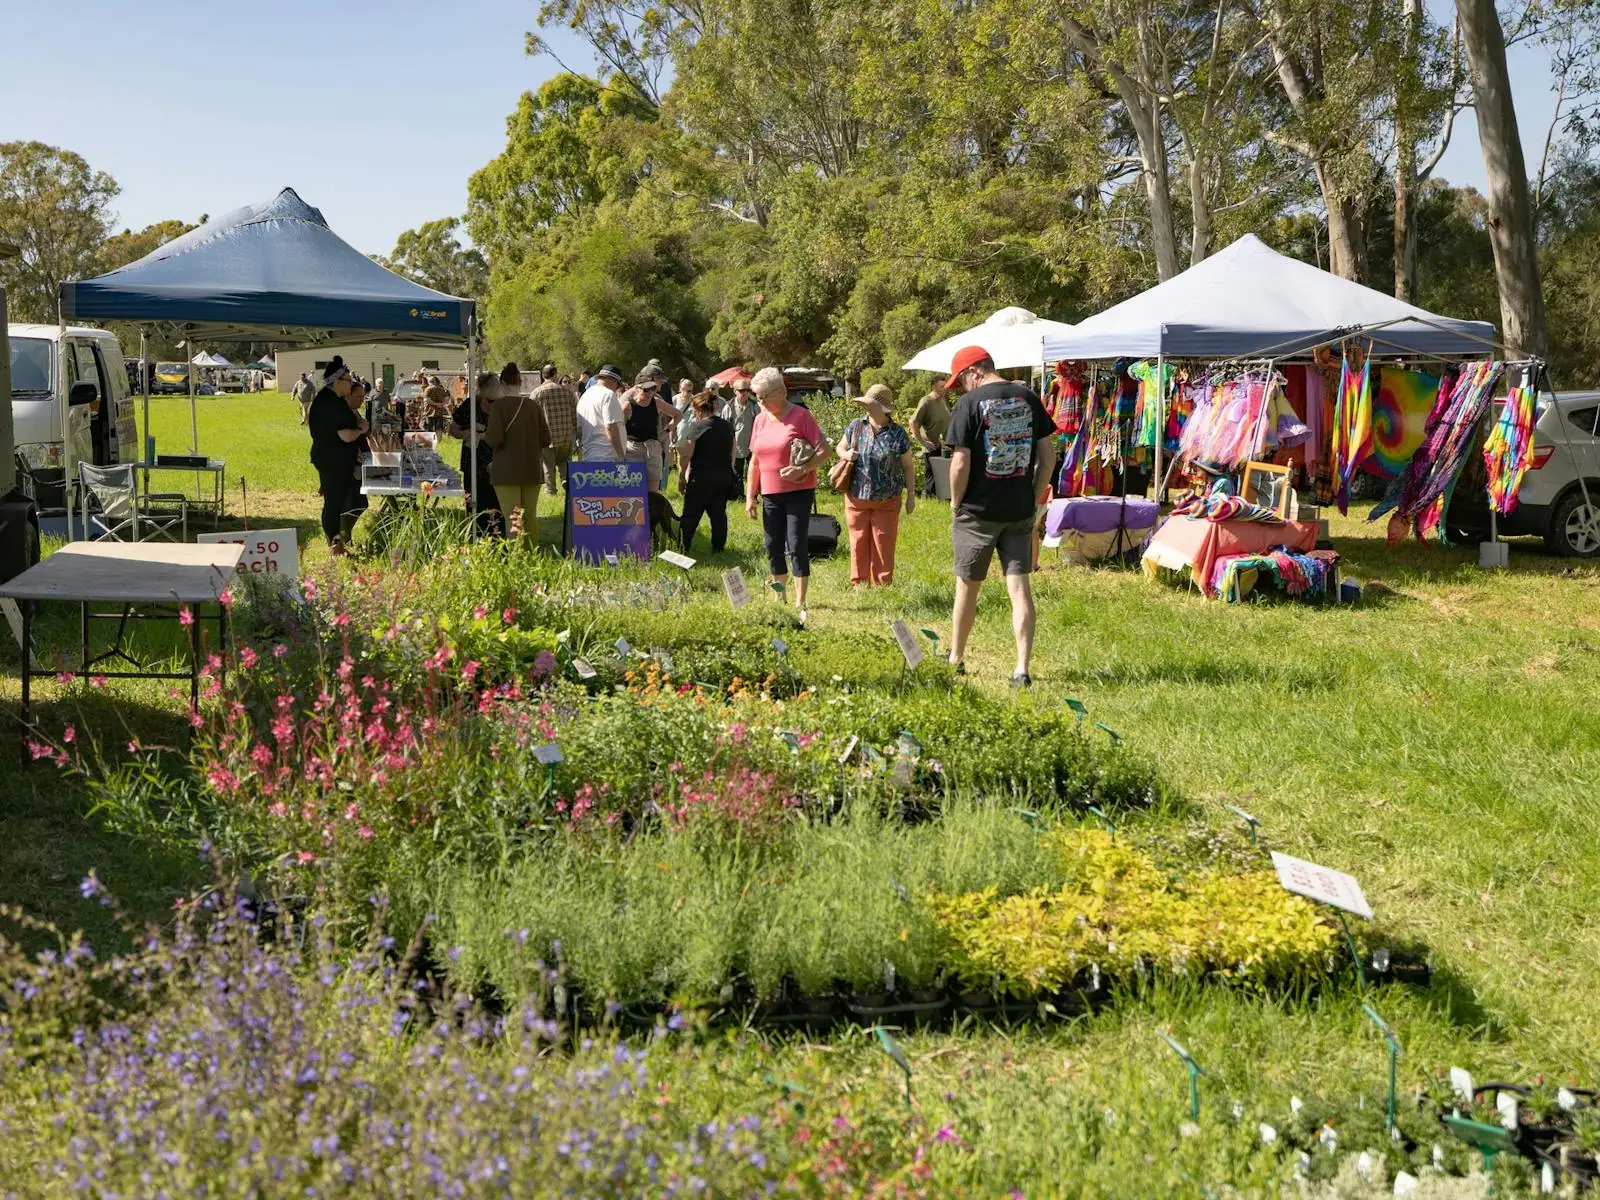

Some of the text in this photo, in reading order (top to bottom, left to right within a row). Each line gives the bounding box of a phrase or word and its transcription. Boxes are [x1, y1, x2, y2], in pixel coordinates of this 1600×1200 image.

[576, 498, 602, 512] Dog
[585, 508, 622, 525] Treats
[235, 556, 278, 575] ach
